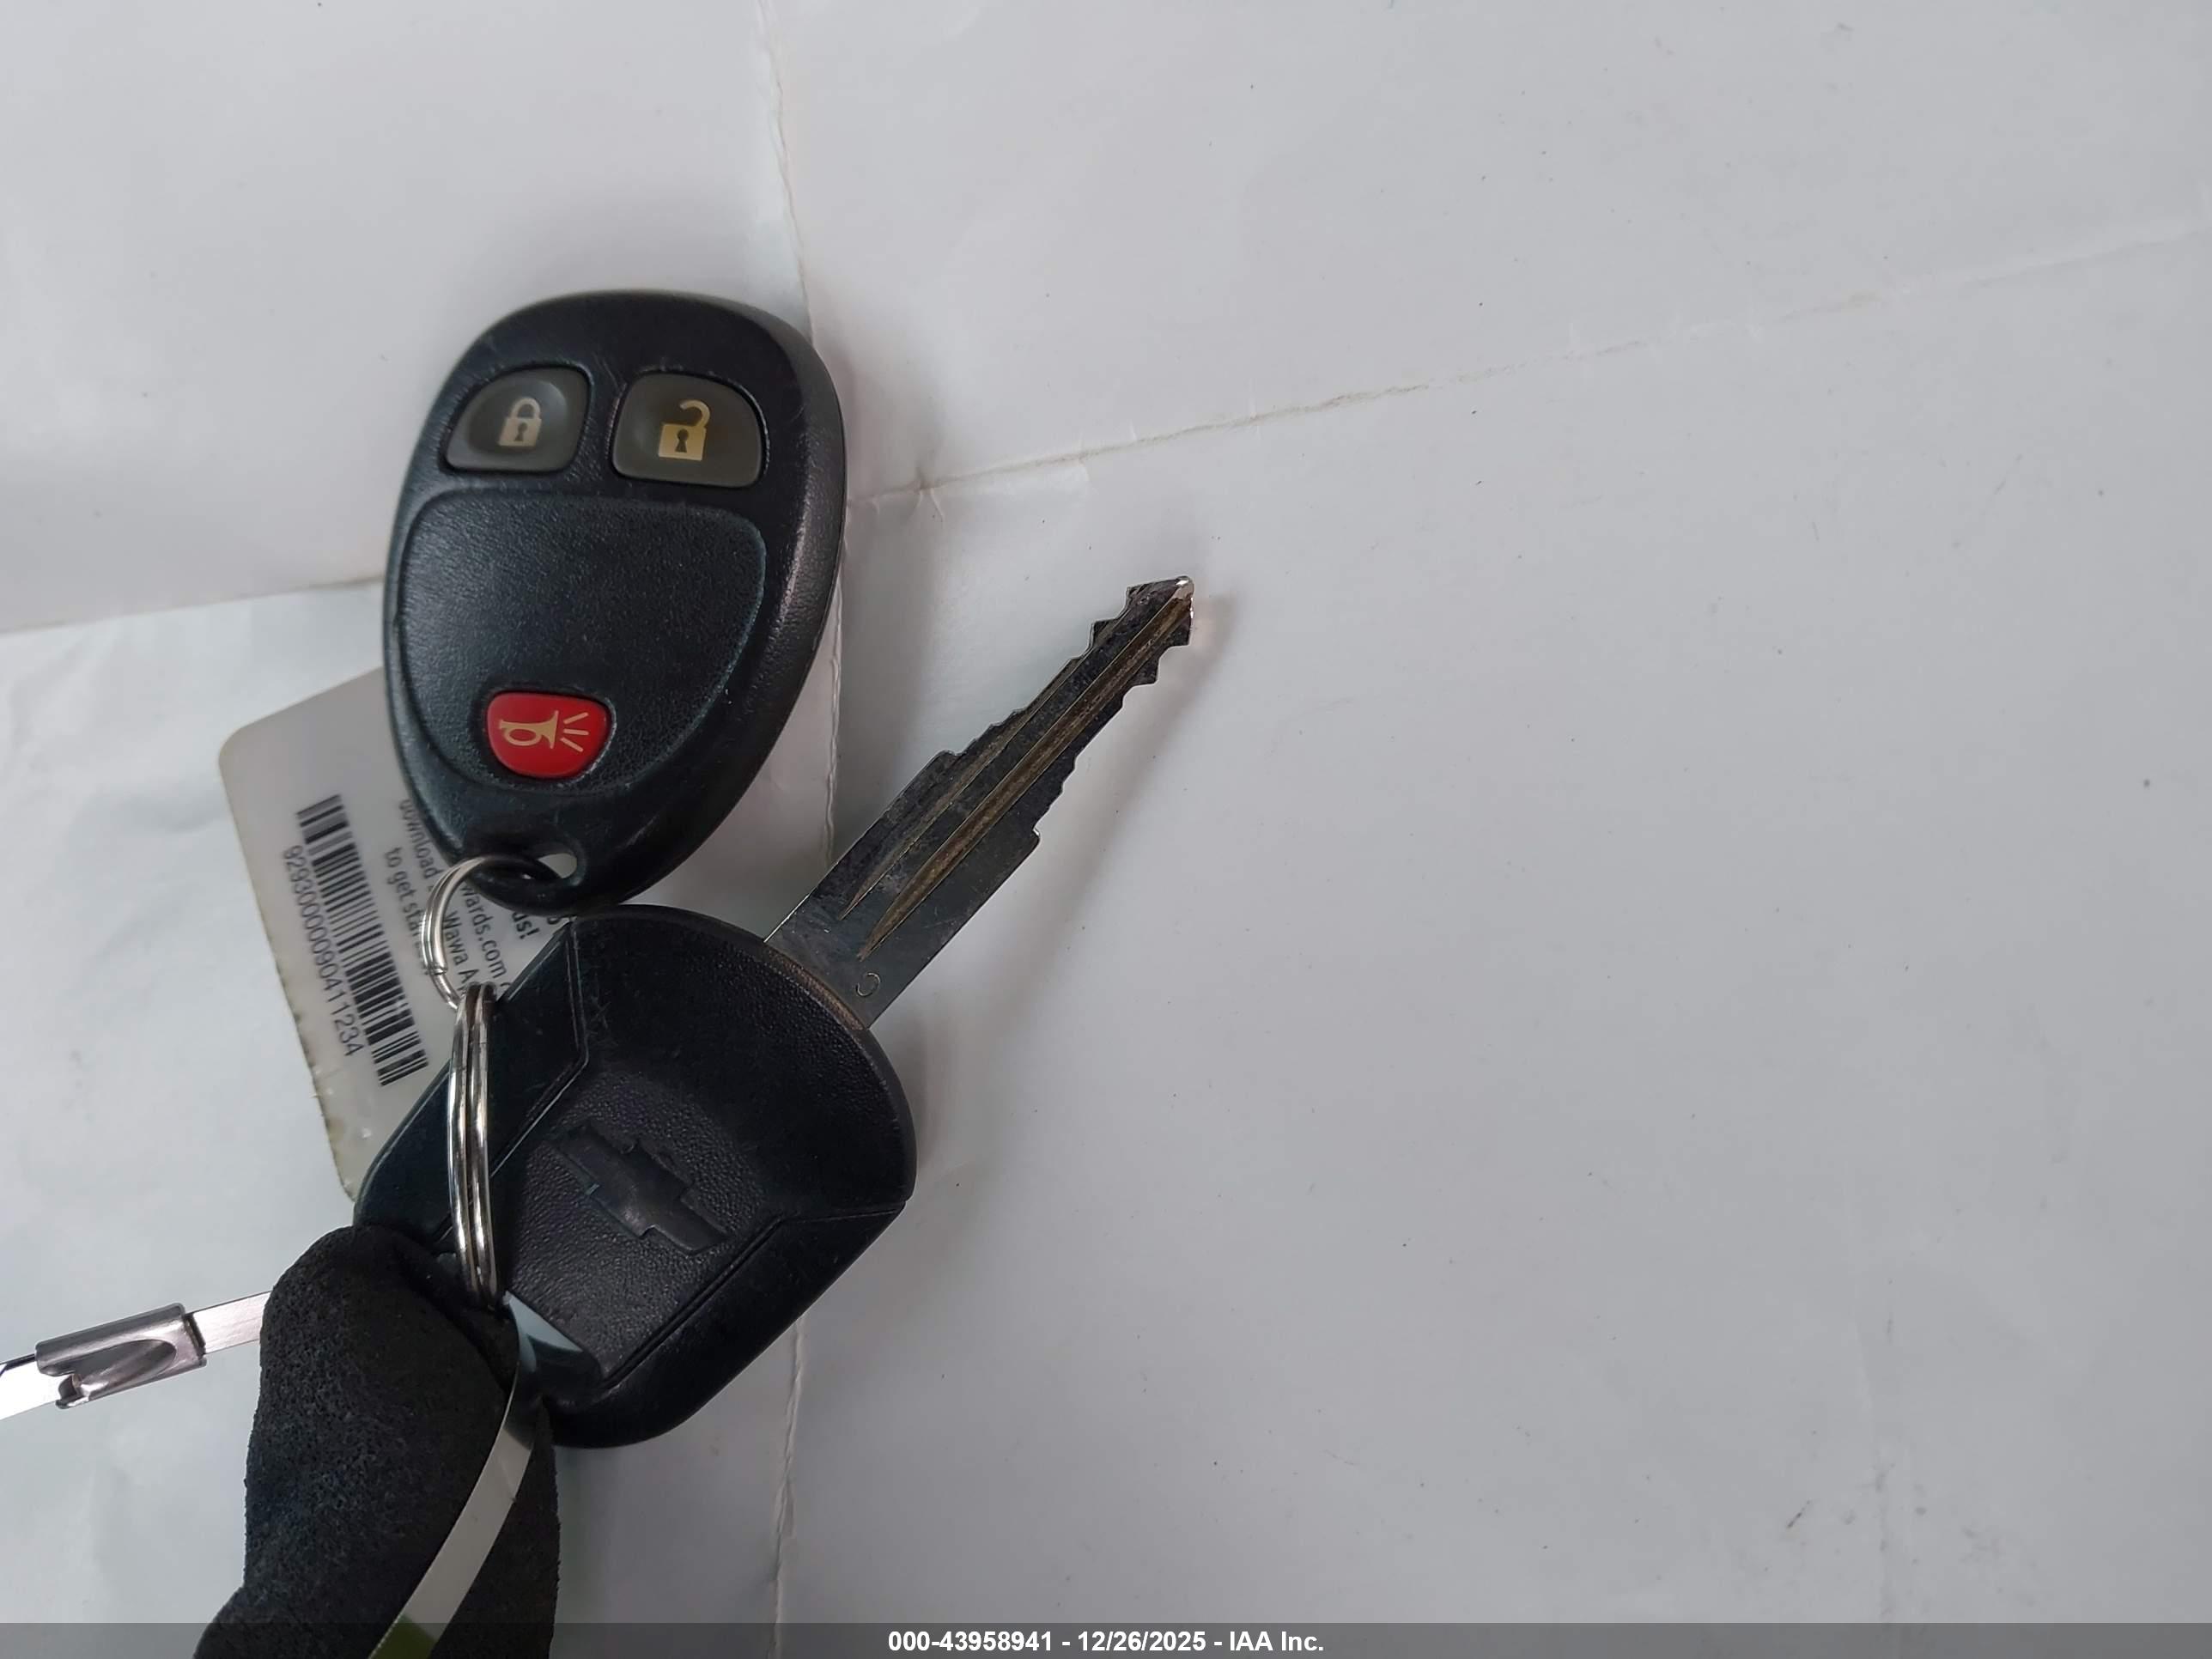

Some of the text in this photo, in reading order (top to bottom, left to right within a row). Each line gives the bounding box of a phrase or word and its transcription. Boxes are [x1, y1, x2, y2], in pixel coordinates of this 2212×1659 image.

[386, 847, 416, 902] to get
[441, 910, 470, 967] Wawa
[461, 884, 508, 979] wards.com
